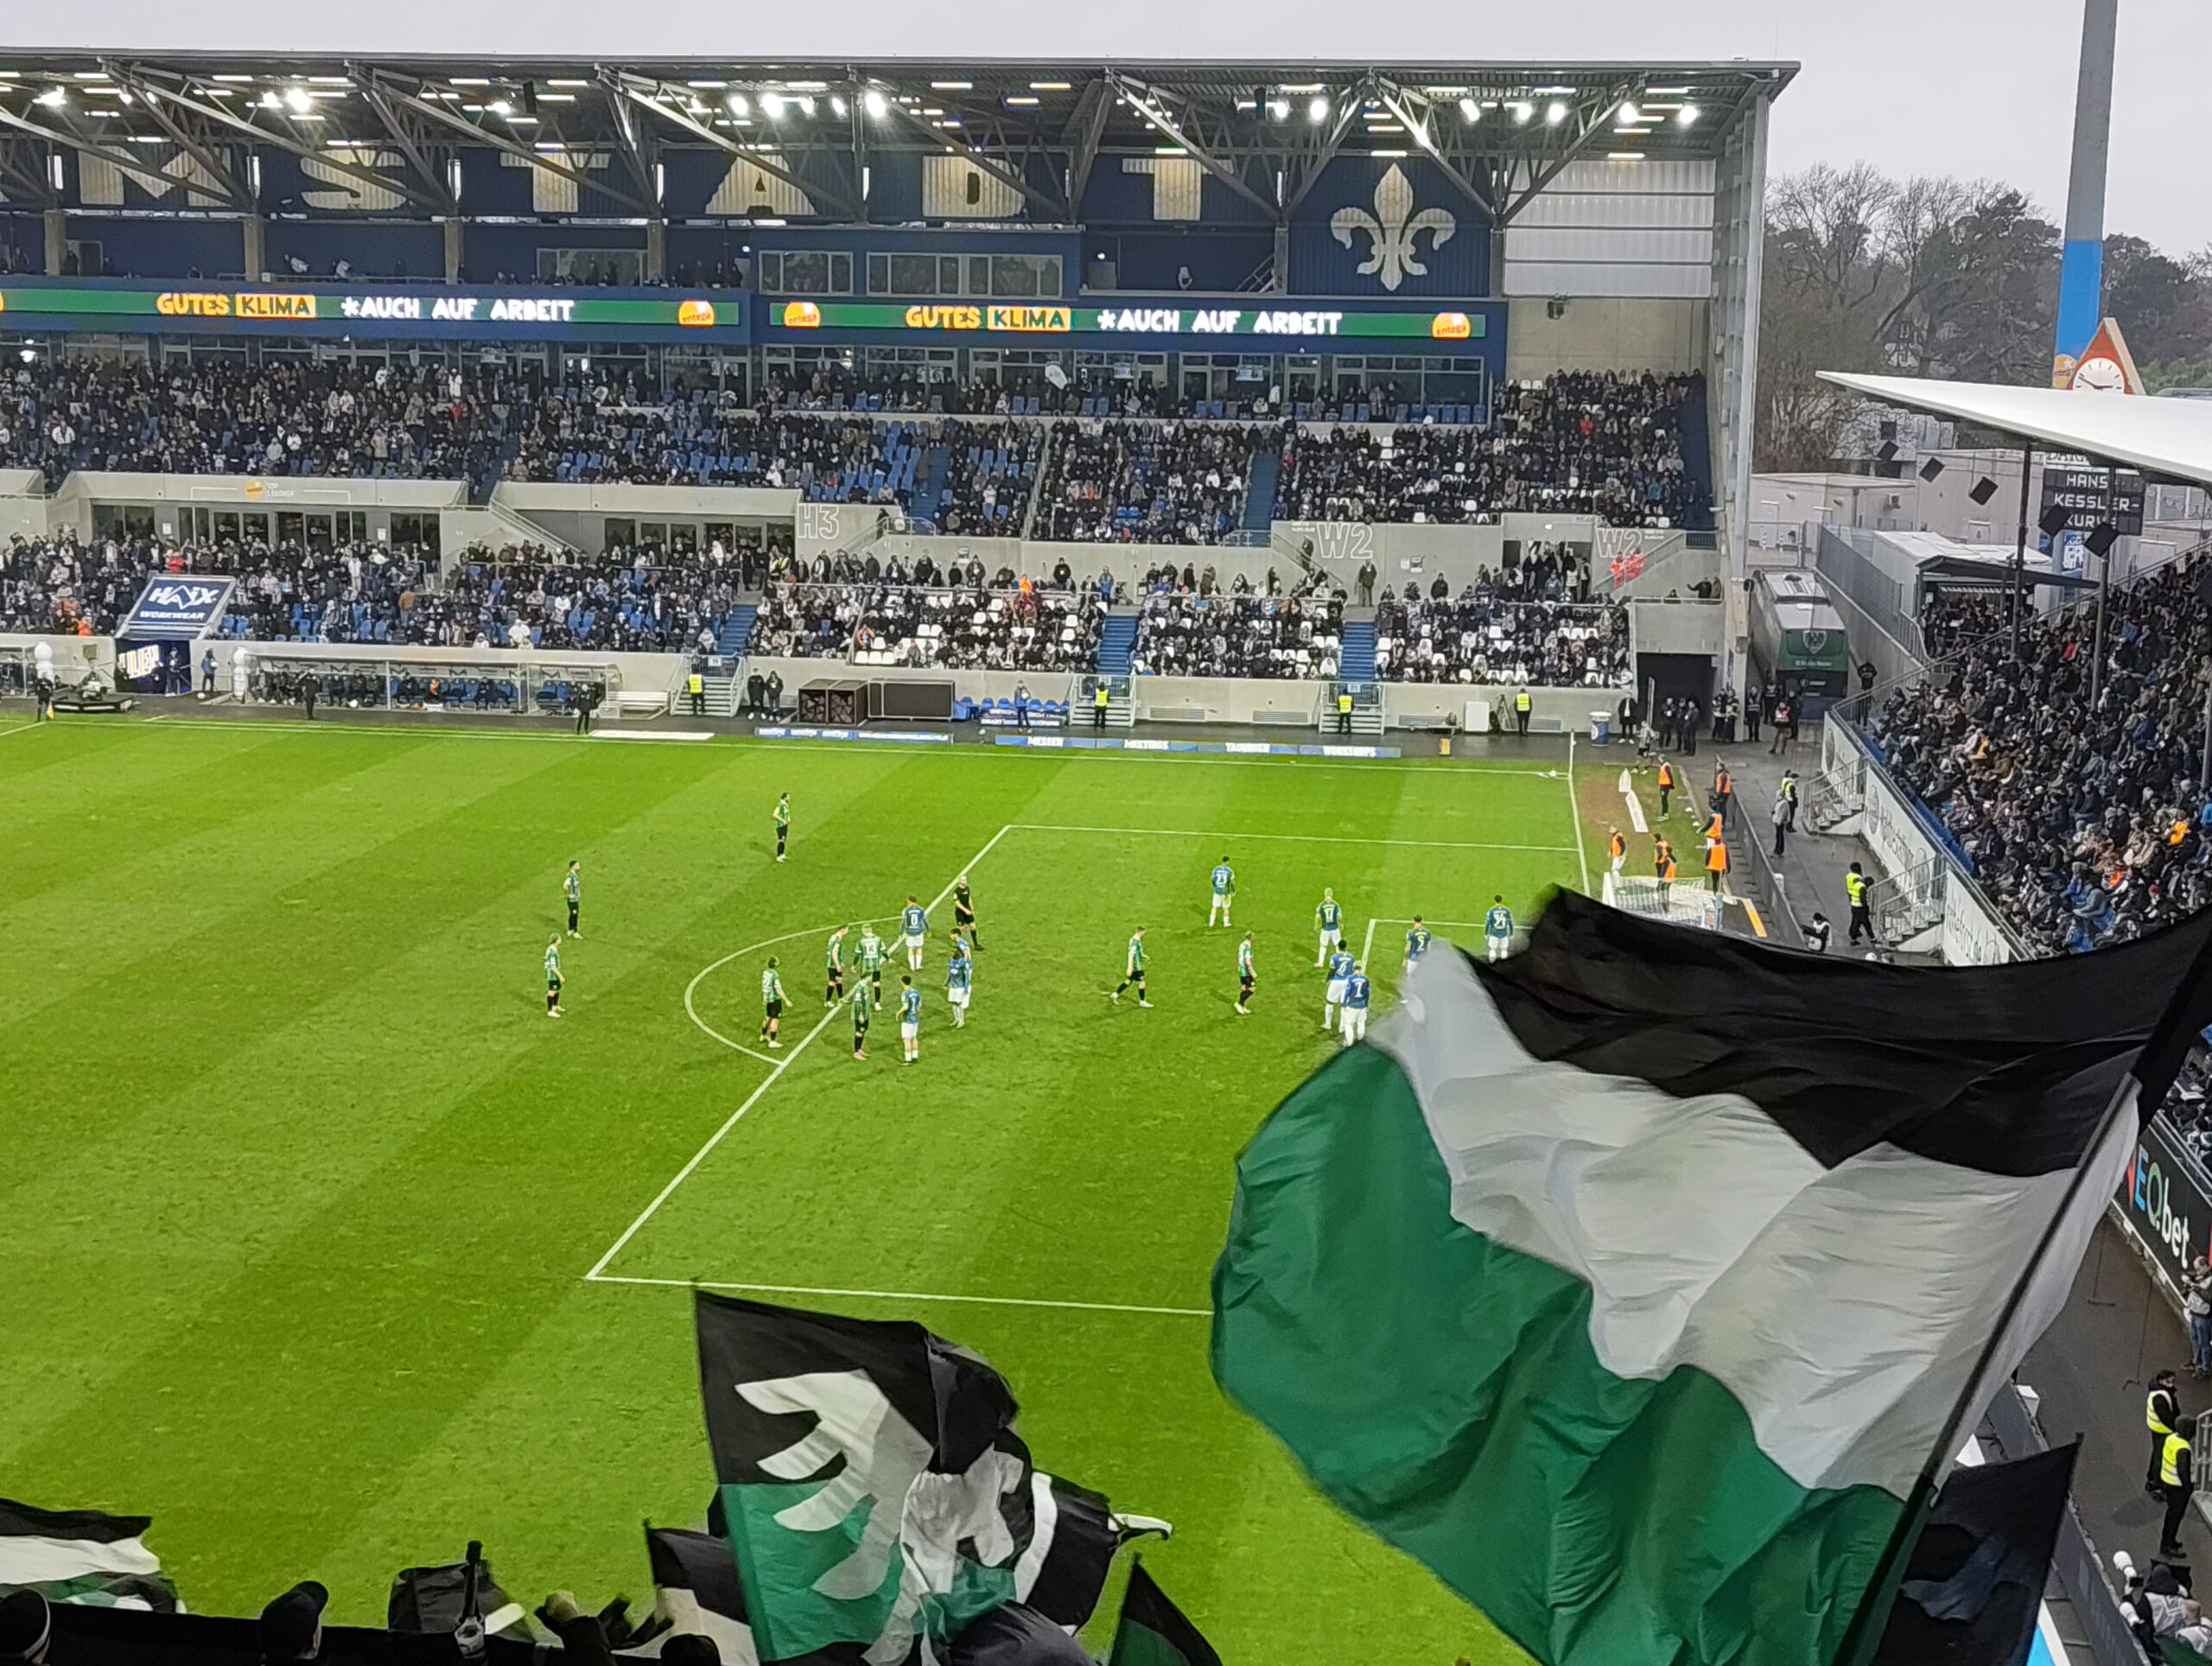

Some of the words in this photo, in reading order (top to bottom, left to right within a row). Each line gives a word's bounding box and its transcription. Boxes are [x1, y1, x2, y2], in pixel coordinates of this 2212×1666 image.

[156, 293, 230, 315] GUTES
[241, 296, 311, 315] KLIMA
[432, 298, 477, 319] AUF
[490, 299, 574, 321] ARBEIT
[906, 306, 982, 328] GUTES
[994, 308, 1065, 328] KLIMA
[1192, 310, 1241, 333] AUF
[1254, 311, 1343, 334] ARBEIT
[2066, 474, 2109, 489] HANS
[797, 504, 840, 540] H3
[1316, 522, 1373, 559] W2
[1596, 528, 1642, 558] W2
[140, 610, 206, 620] WORKWEAR
